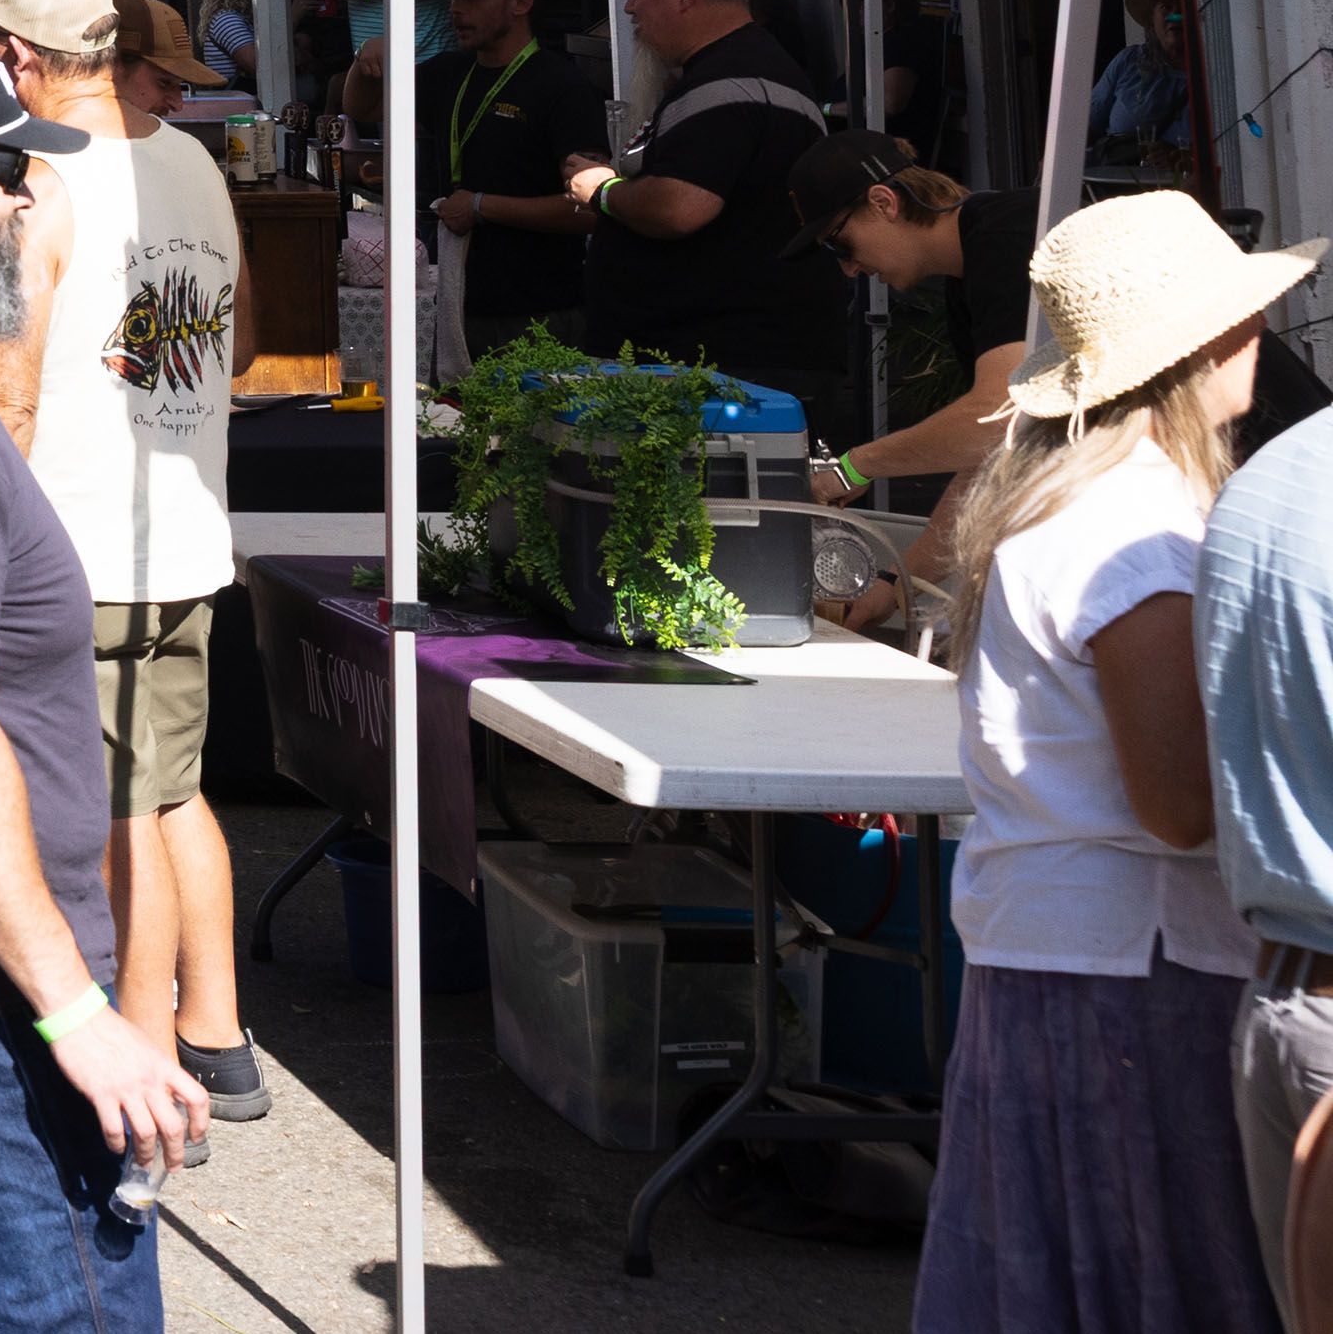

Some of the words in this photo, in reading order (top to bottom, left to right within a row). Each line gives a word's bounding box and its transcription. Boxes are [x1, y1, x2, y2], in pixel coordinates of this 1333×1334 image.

[143, 246, 164, 260] To
[167, 238, 197, 253] The
[200, 240, 229, 264] Bone
[133, 413, 155, 428] One
